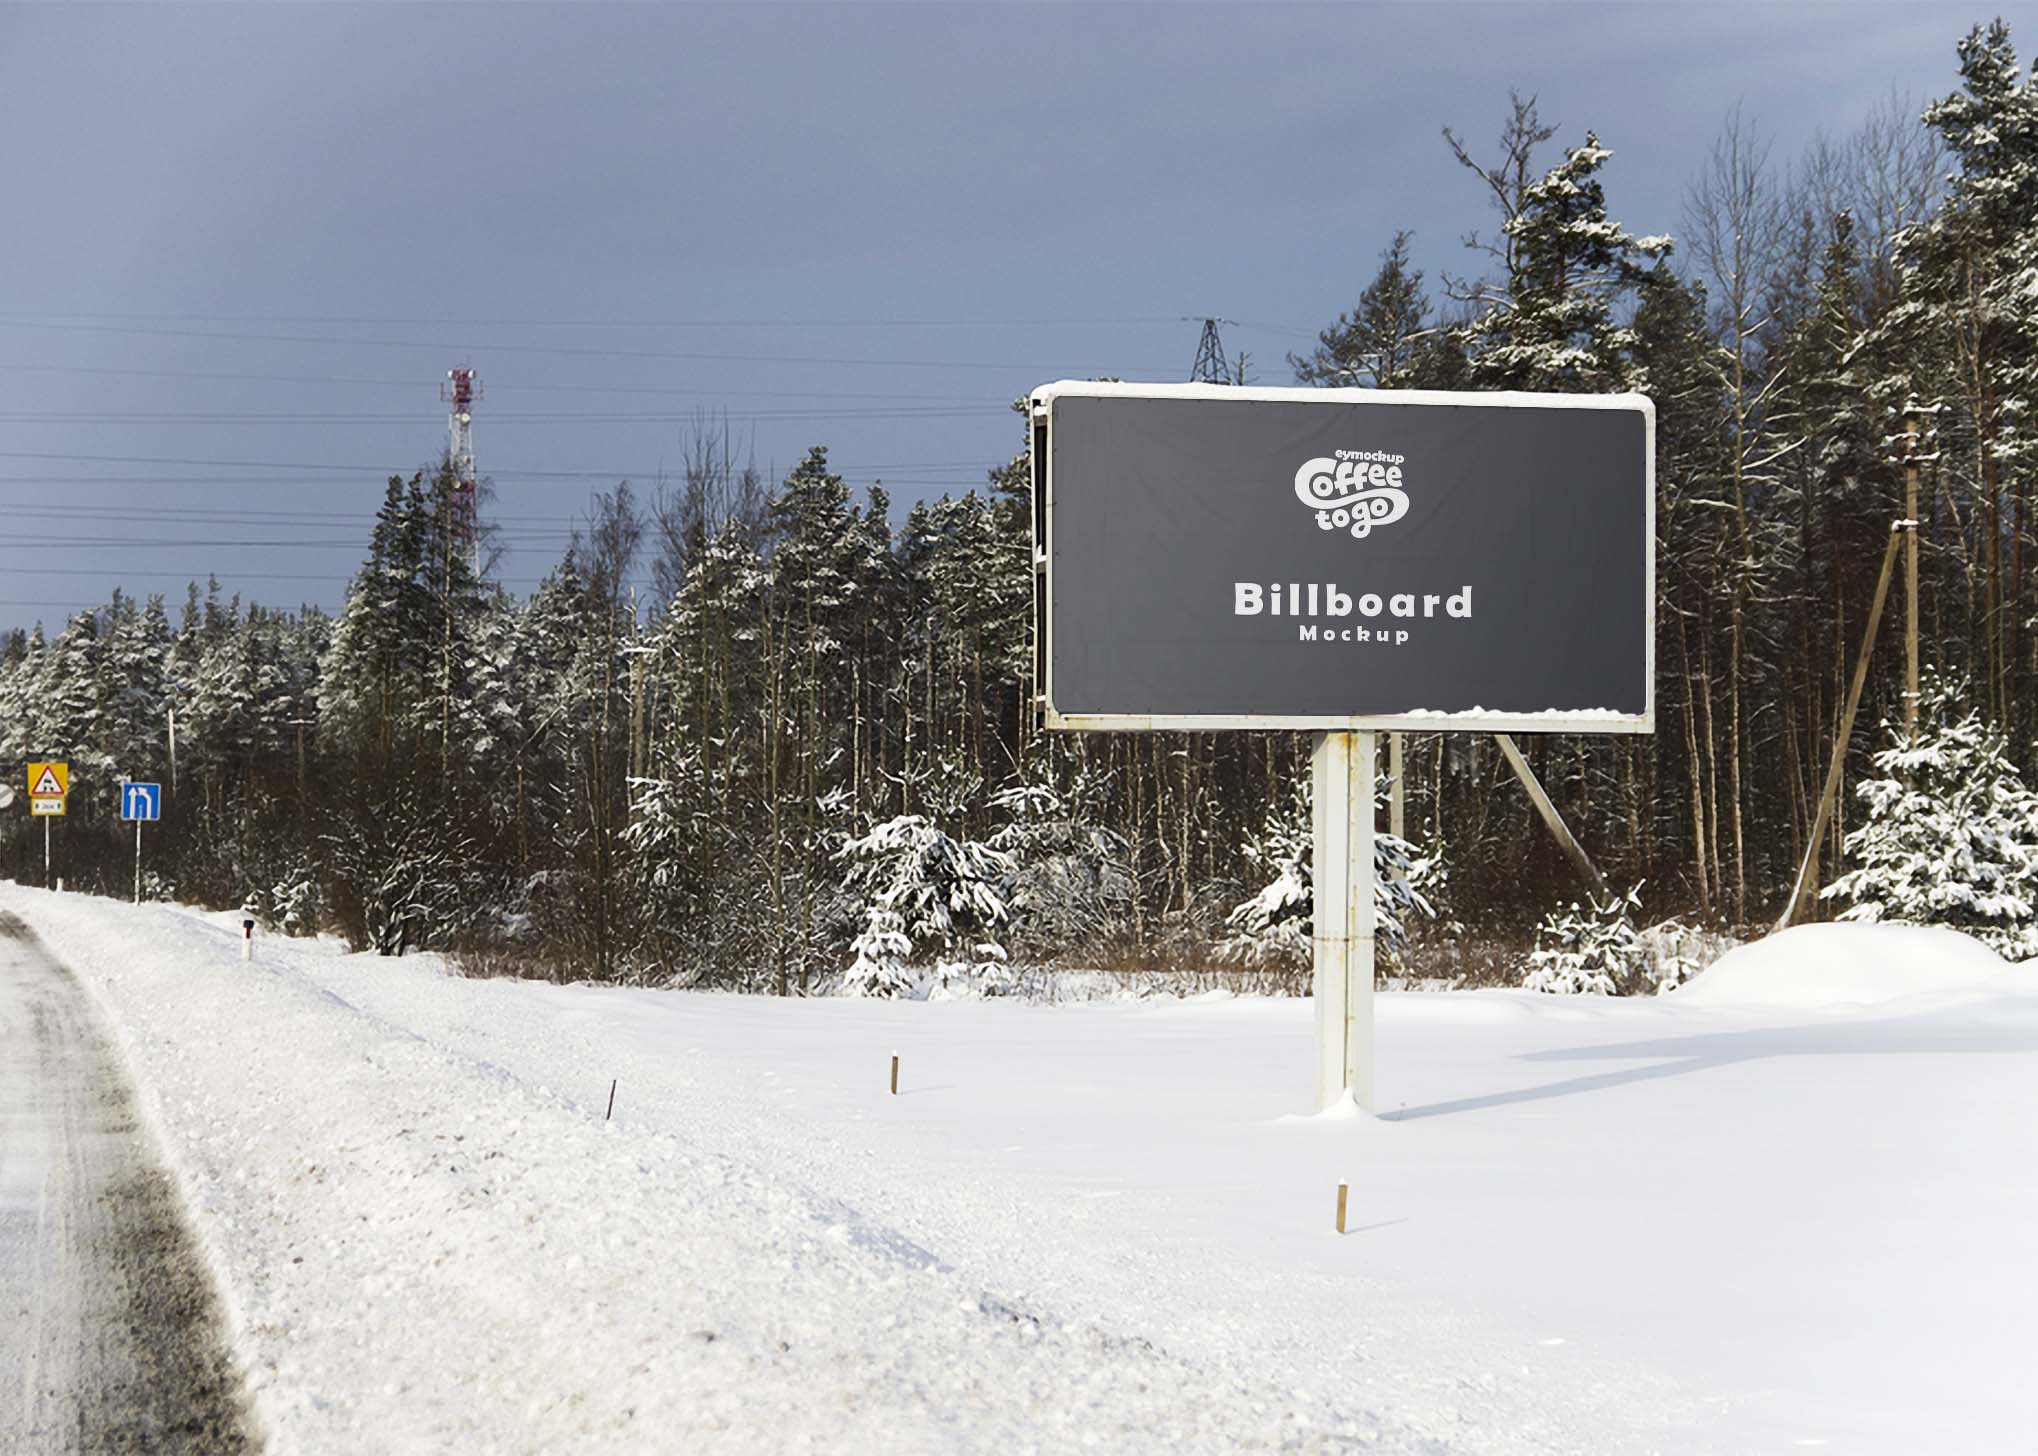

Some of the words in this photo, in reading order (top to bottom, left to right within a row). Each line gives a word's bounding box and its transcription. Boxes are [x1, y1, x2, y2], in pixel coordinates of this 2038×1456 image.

[1335, 449, 1405, 465] eymockup
[1294, 457, 1403, 510] Coffee
[1234, 582, 1472, 617] Billboard
[1299, 625, 1409, 645] Mockup
